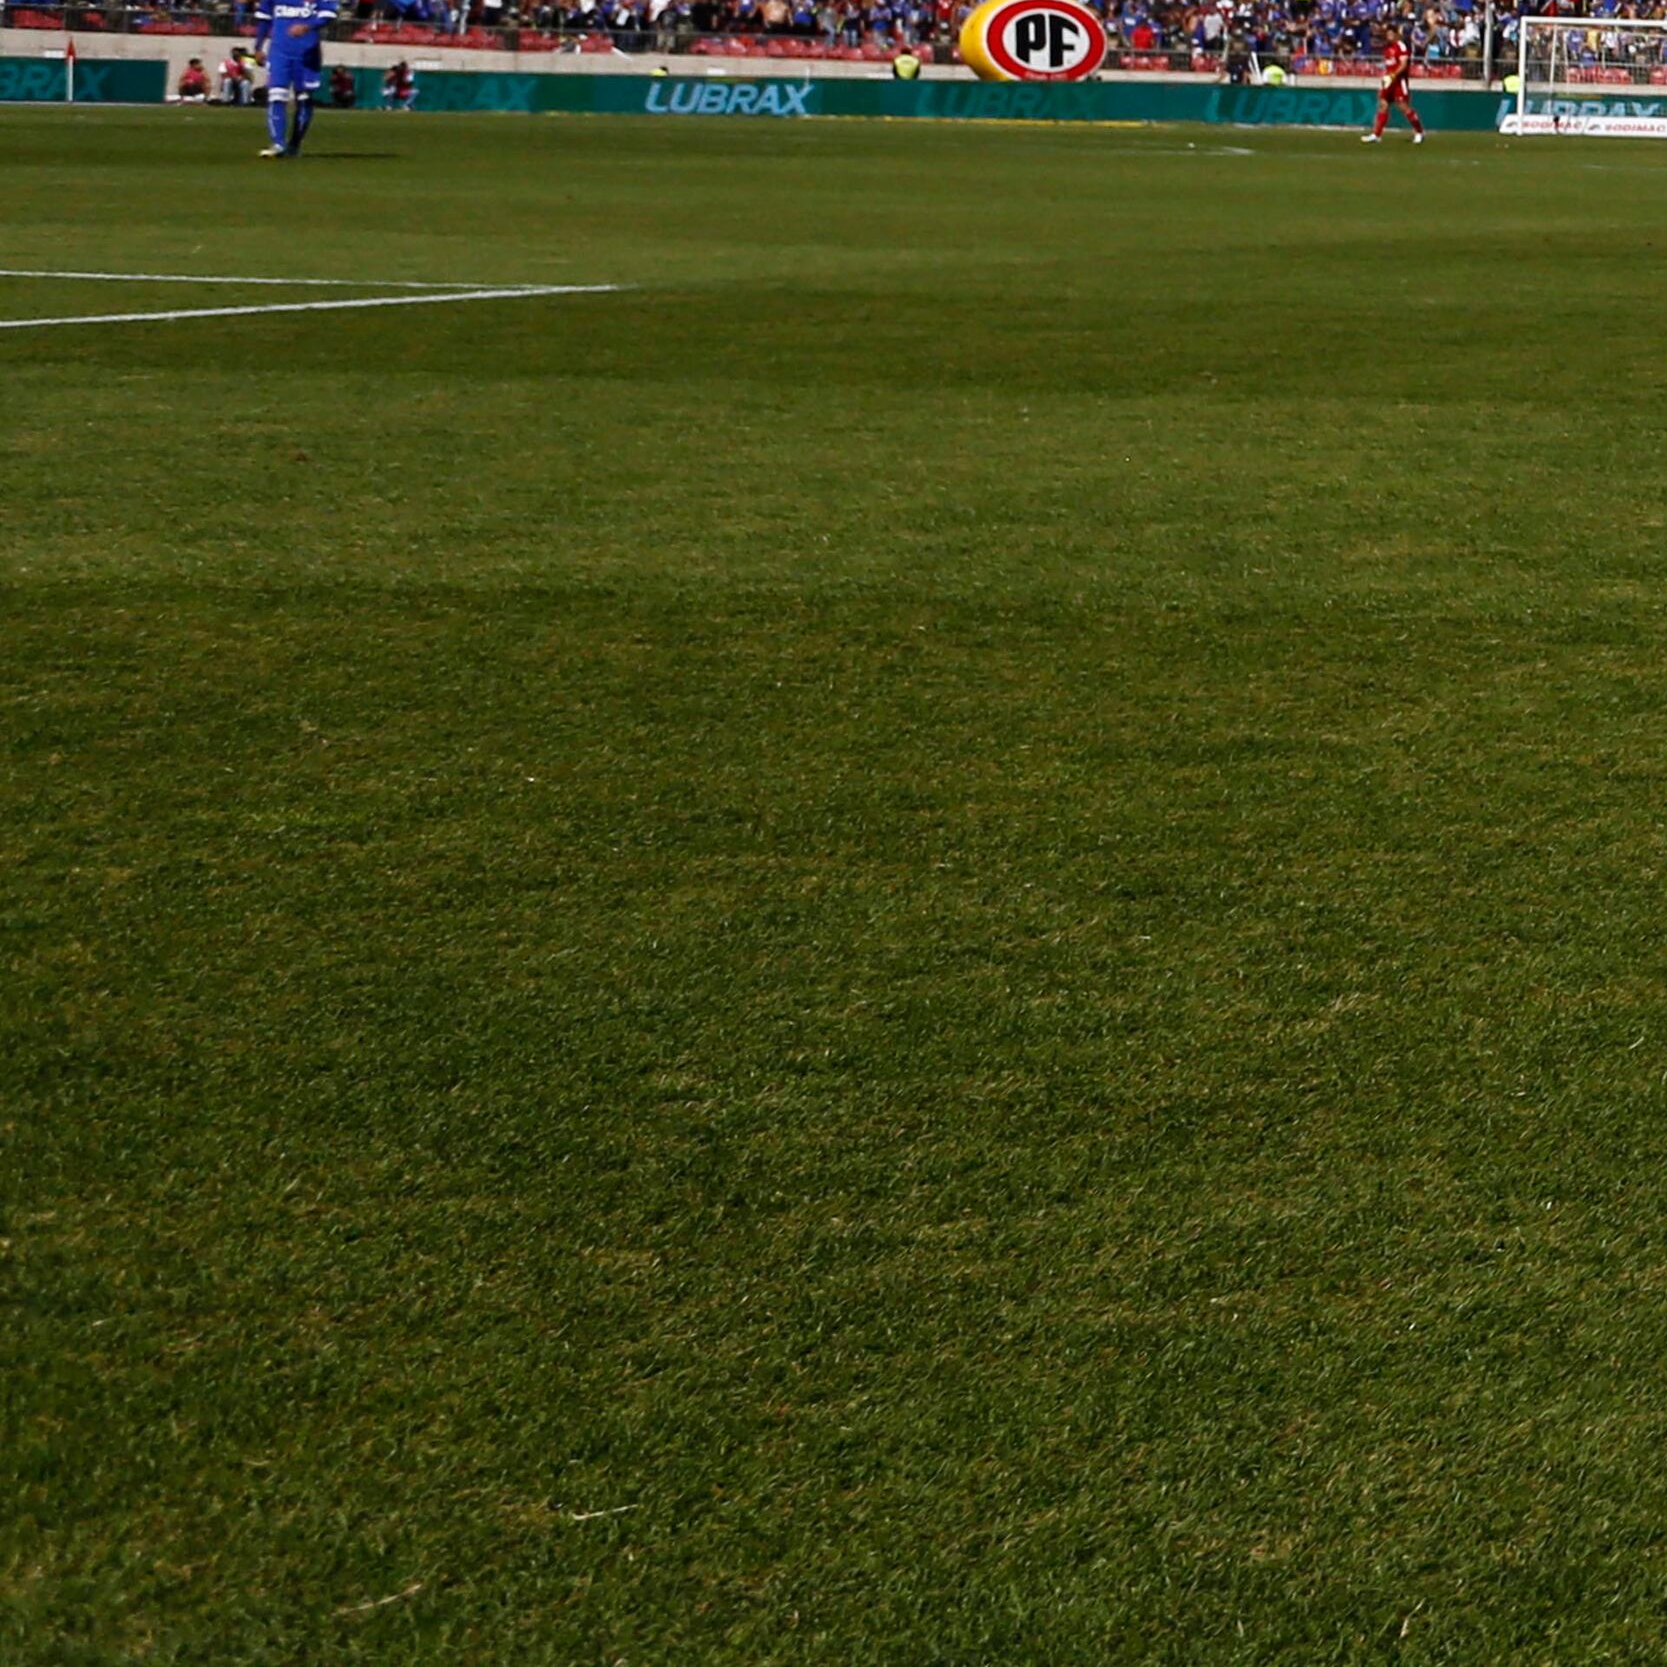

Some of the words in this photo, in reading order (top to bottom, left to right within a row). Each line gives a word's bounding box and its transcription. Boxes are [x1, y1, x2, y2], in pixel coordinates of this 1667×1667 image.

[1015, 13, 1079, 68] PF
[645, 83, 814, 116] LUBRAX
[1604, 124, 1666, 132] SODIMAC
